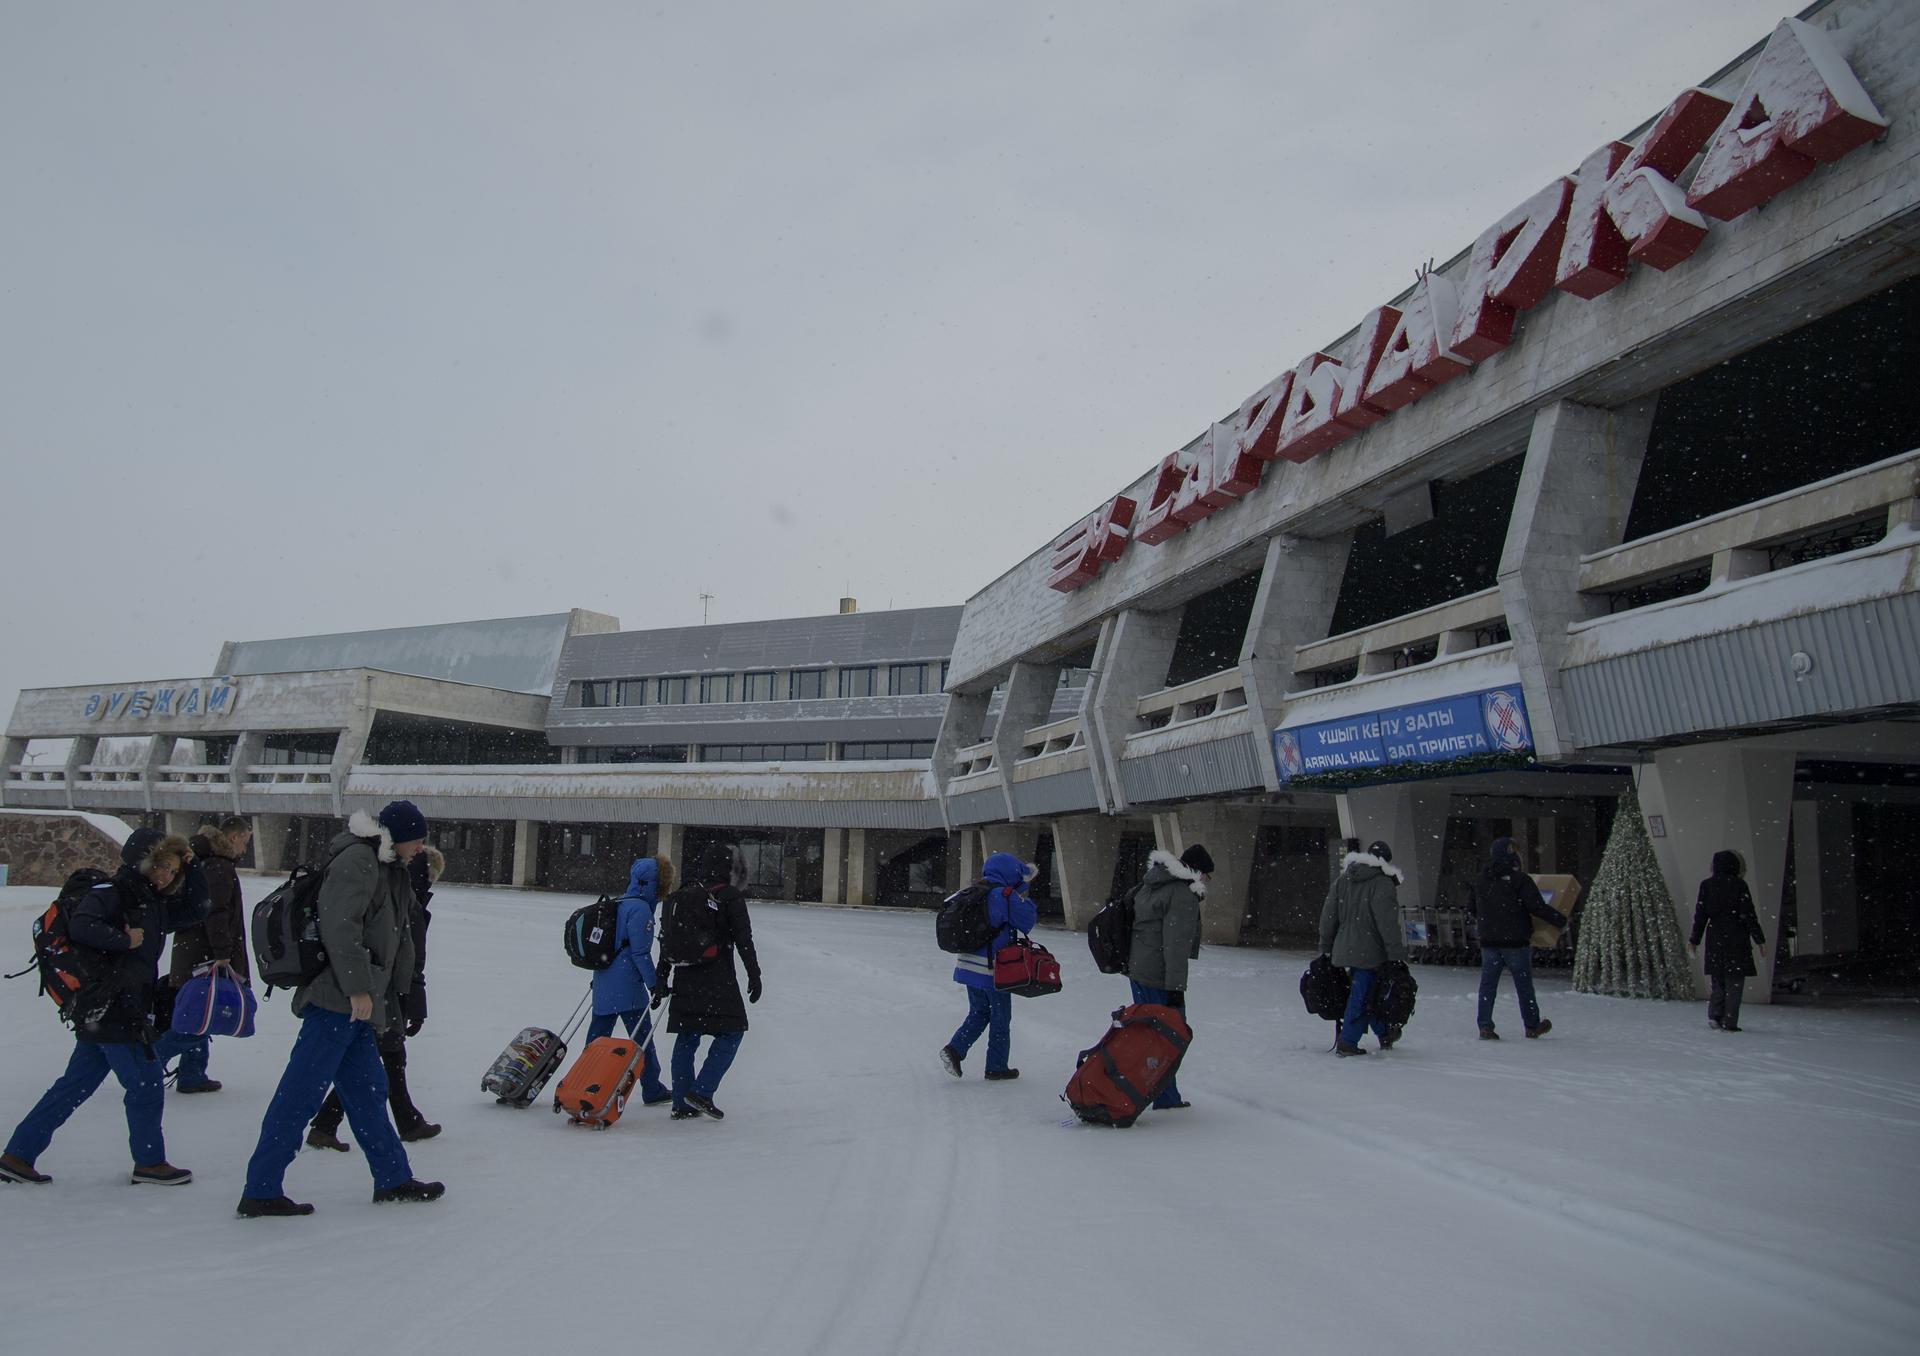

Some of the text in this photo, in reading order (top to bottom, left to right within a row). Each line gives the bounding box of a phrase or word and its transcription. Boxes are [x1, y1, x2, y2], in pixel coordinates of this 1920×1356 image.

[84, 676, 236, 719] ӘУЕЖАЙ
[1362, 718, 1399, 740] КЕЛУ
[1405, 708, 1454, 733] ЗАЛЫ
[1304, 748, 1380, 769] ARRIVAL HALL
[1388, 733, 1487, 760] ЗАЛ ПРИЛЕТА
